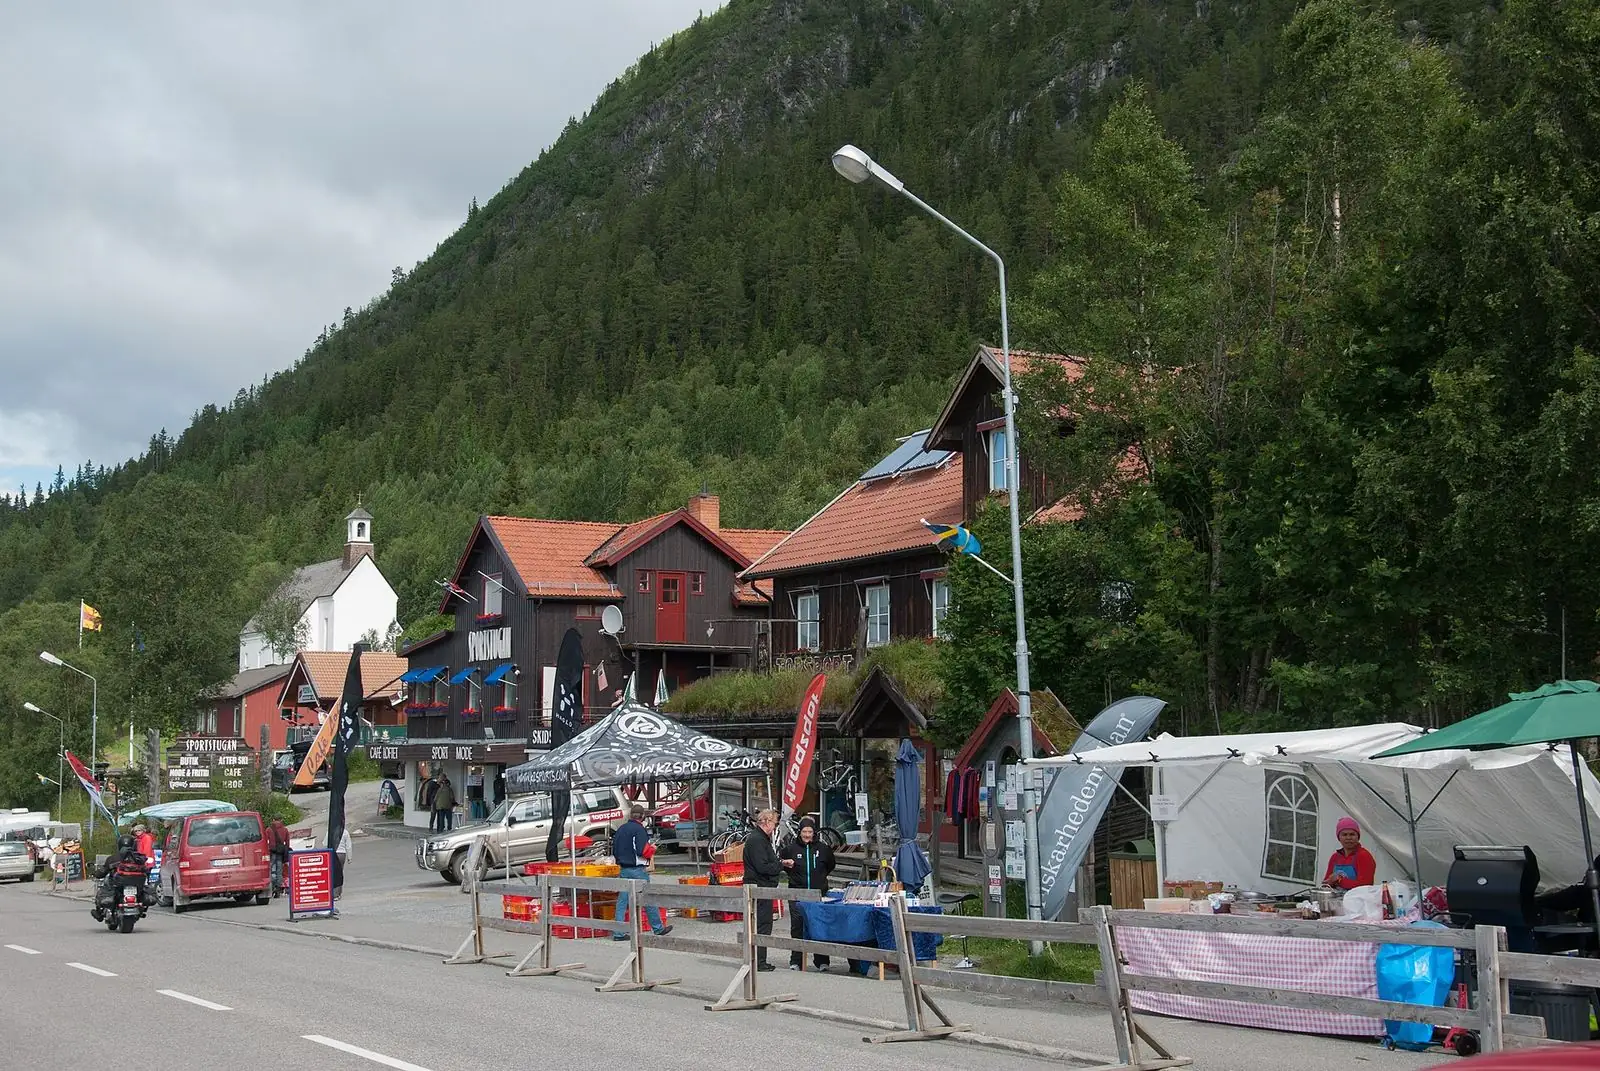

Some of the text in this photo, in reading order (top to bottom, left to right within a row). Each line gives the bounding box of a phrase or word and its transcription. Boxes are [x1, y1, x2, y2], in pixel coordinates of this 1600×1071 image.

[186, 739, 237, 751] SPORTSTUGAN
[785, 693, 819, 802] topsport
[431, 746, 473, 760] SPORT MODE
[180, 756, 199, 766] BUTIK
[615, 757, 763, 776] WWW.K2SPORTS.COM
